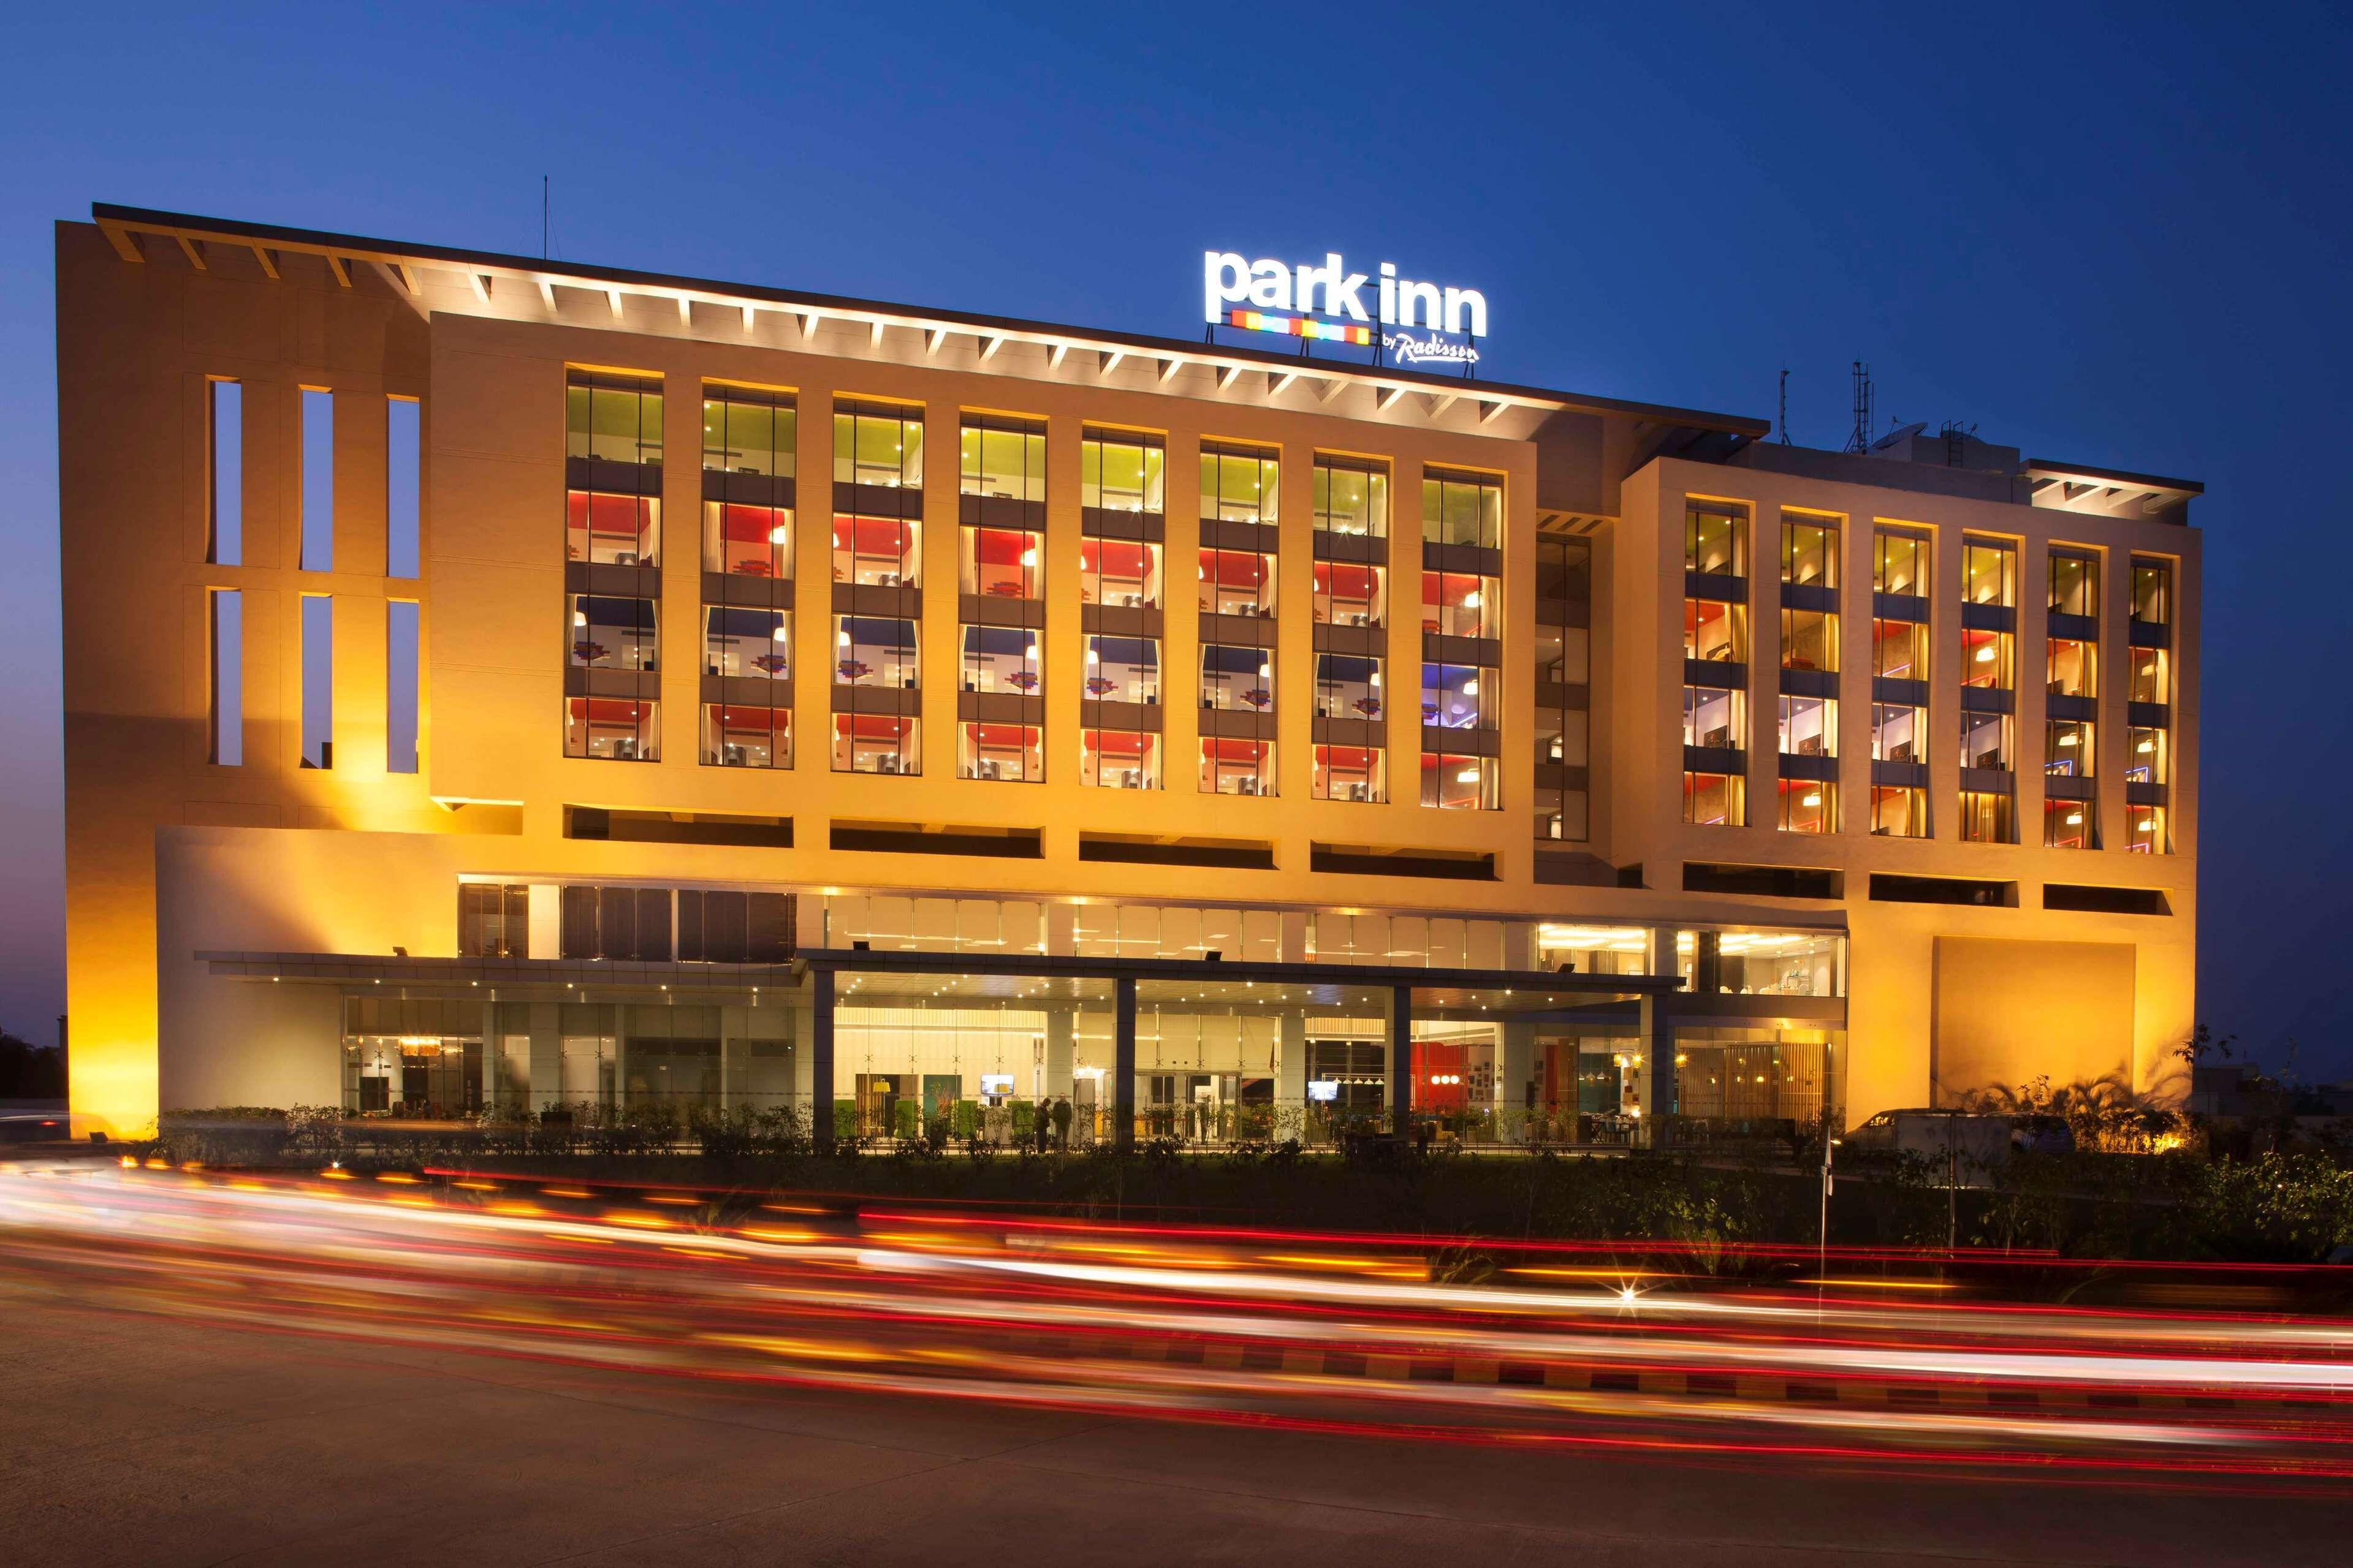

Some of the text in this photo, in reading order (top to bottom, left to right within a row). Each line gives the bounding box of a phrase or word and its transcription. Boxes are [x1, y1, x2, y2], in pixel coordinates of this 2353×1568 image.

[1205, 251, 1486, 337] park inn
[1382, 333, 1480, 363] by Radisson
